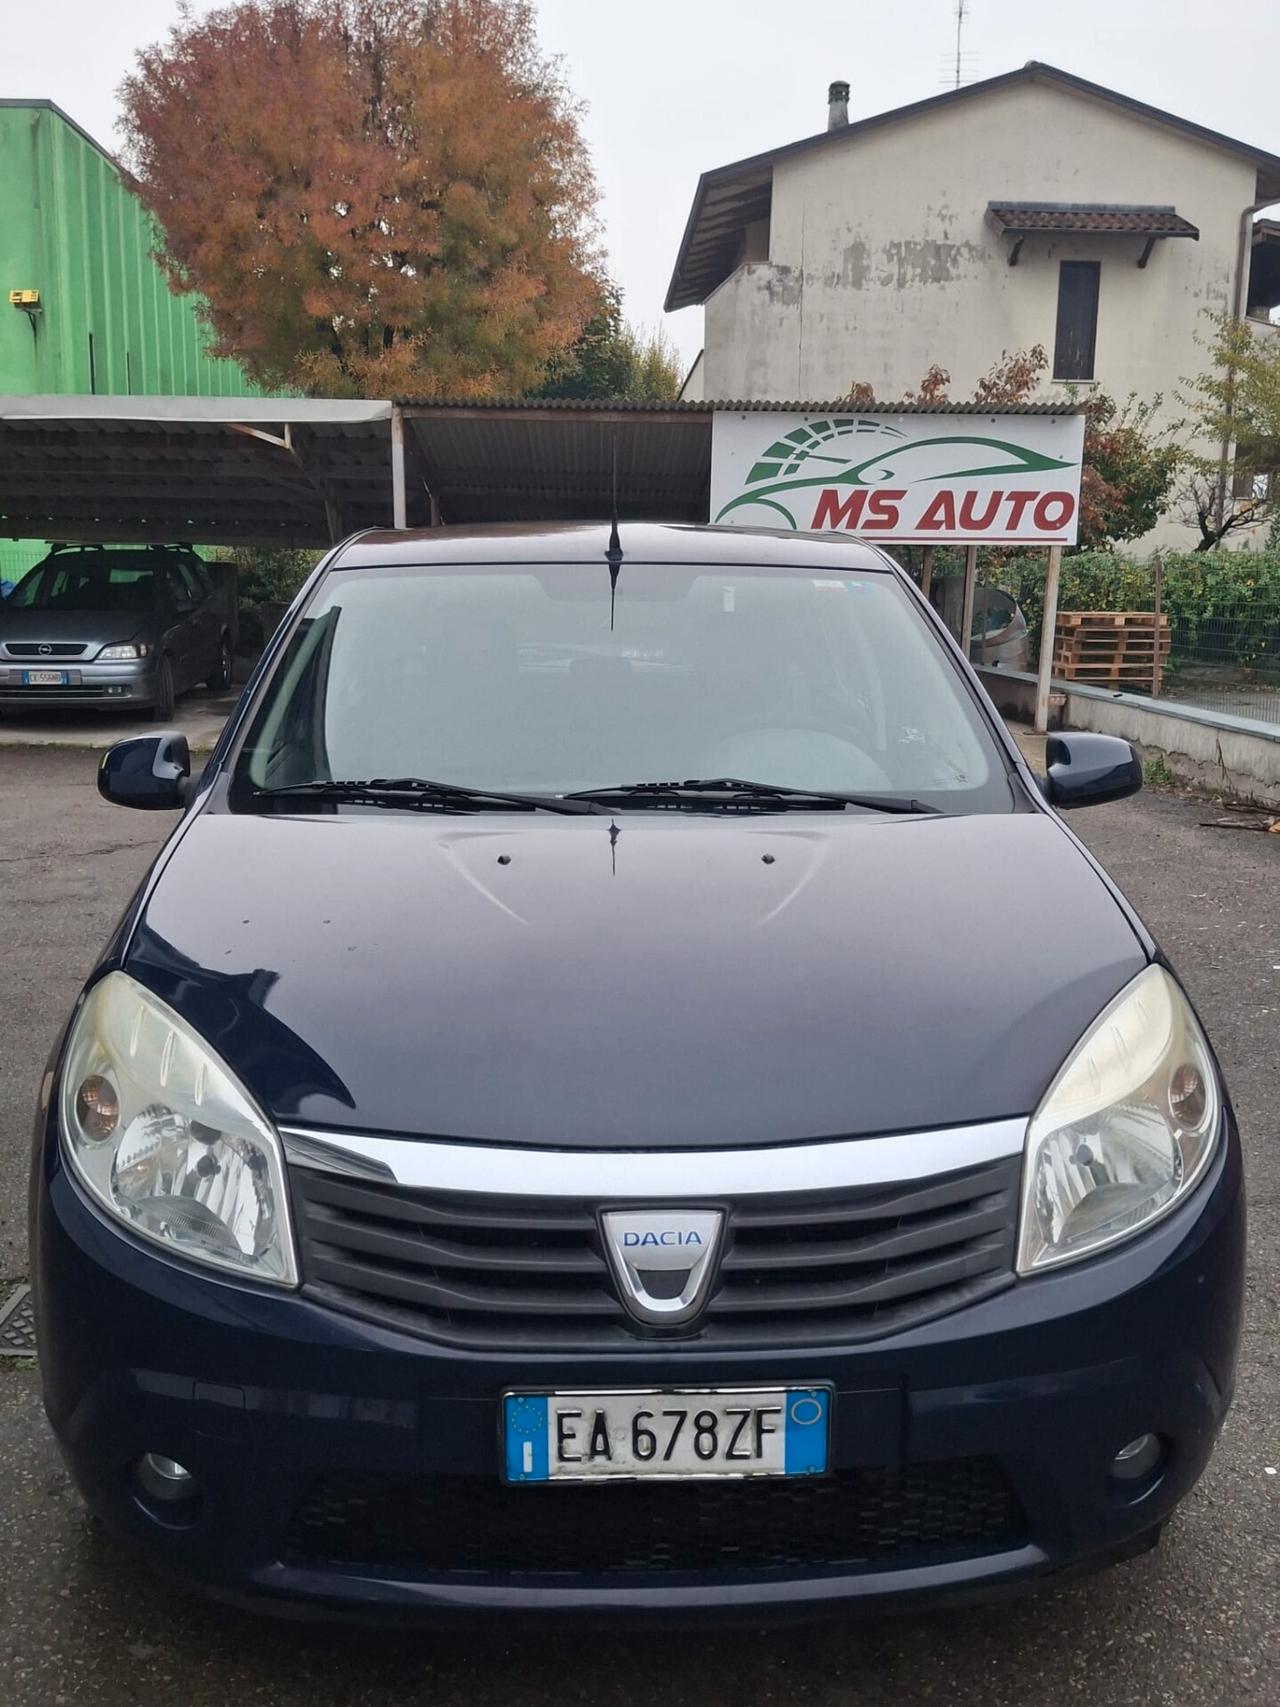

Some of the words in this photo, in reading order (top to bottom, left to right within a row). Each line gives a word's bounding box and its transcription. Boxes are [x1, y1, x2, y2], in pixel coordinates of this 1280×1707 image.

[810, 489, 908, 530] MS
[914, 490, 1075, 531] AUTO
[623, 1231, 702, 1246] DACIA
[556, 1409, 612, 1462] EA
[632, 1406, 781, 1461] 678ZF
